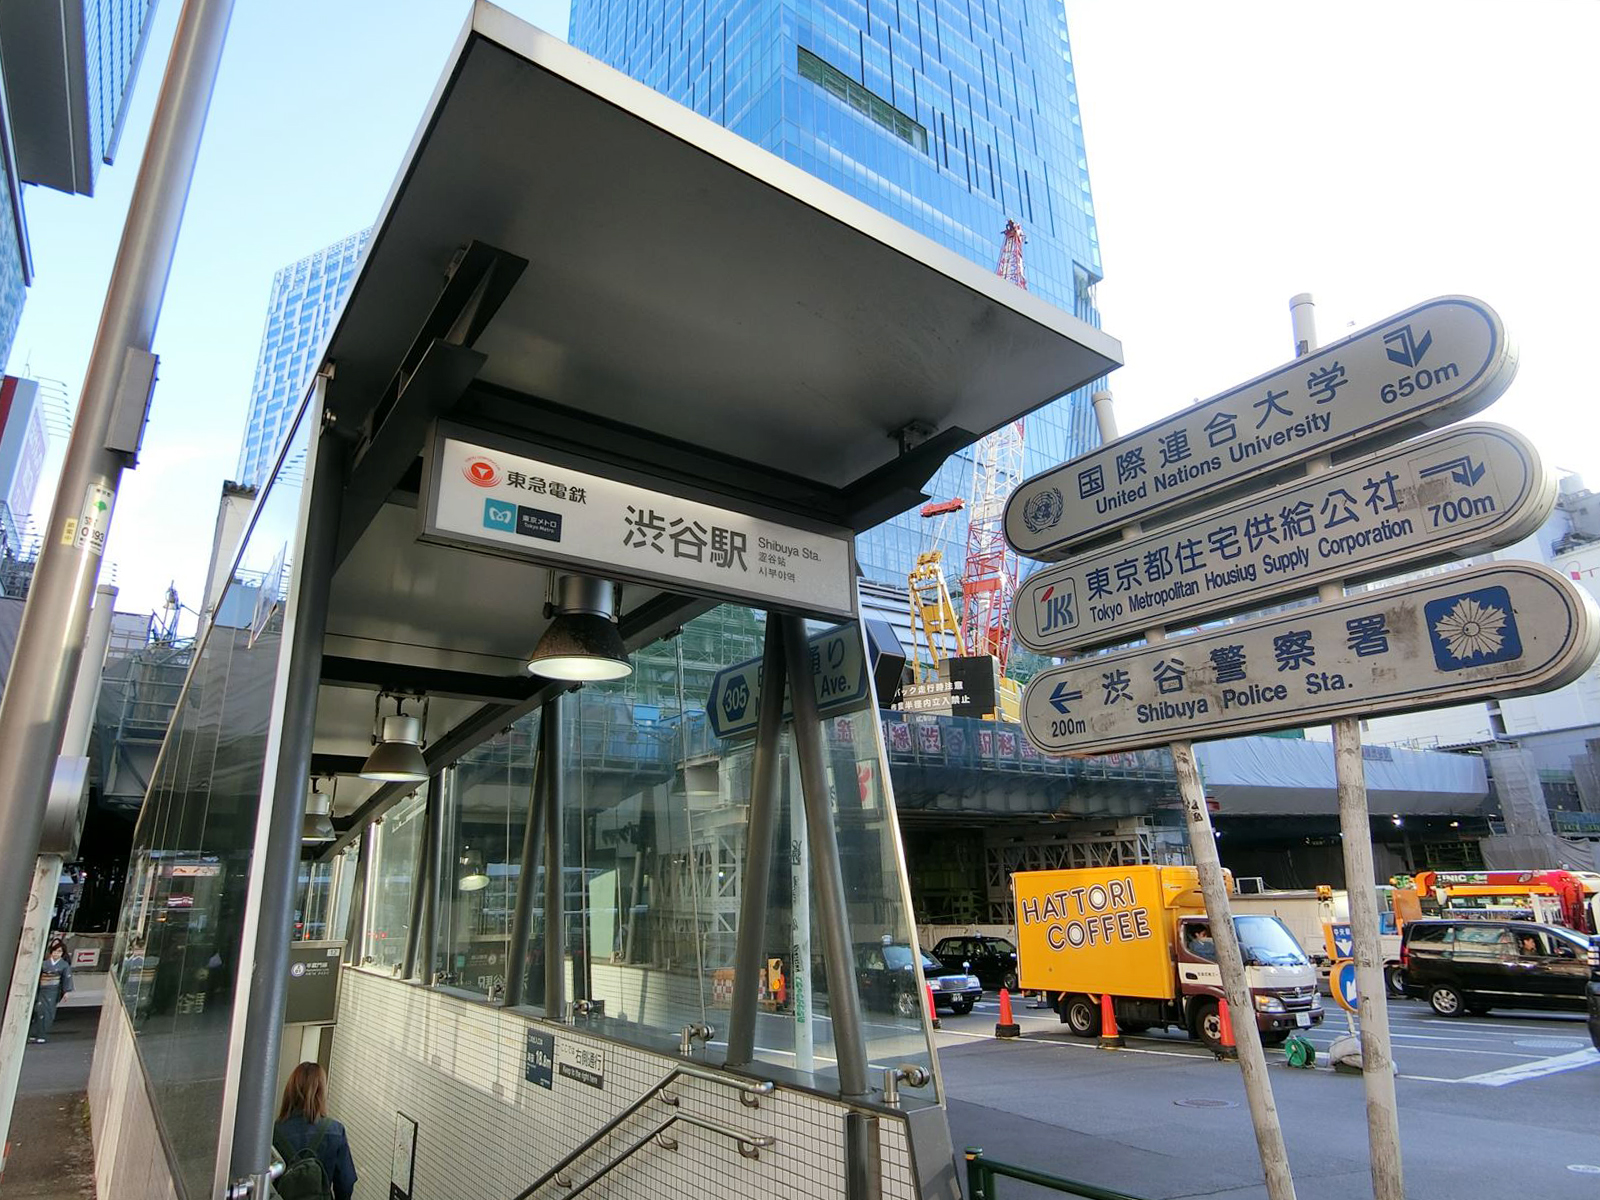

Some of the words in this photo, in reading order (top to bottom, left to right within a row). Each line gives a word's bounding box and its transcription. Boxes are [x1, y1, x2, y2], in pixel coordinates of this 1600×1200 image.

[1380, 362, 1459, 404] 650m
[1078, 360, 1349, 500] 国際連合大学
[1096, 482, 1147, 515] United
[1154, 456, 1222, 493] Nations
[1229, 411, 1331, 463] University
[506, 470, 587, 505] 東急電鉄
[522, 514, 557, 528] 東京メトロ
[524, 522, 538, 531] Tokyo
[539, 525, 555, 534] Metro
[1427, 495, 1496, 528] 700m
[623, 504, 748, 573] 渋谷駅
[758, 537, 799, 557] Shibuya
[802, 547, 821, 562] Sta.
[1085, 471, 1404, 601] 東京都住宅供給公社
[1090, 604, 1123, 623] Tokyo
[1128, 580, 1200, 613] Metropolitan
[1262, 545, 1309, 574] Supply
[1318, 516, 1414, 557] Corporation
[1102, 613, 1390, 706] 渋谷警察署
[725, 683, 747, 713] 305
[820, 675, 851, 698] Ave.
[1137, 698, 1209, 724] Shibuya
[1222, 684, 1288, 709] Police
[1305, 672, 1353, 695] Sta.
[1051, 717, 1087, 738] 200m
[1022, 876, 1136, 925] HATTORI
[1046, 907, 1152, 951] COFFEE
